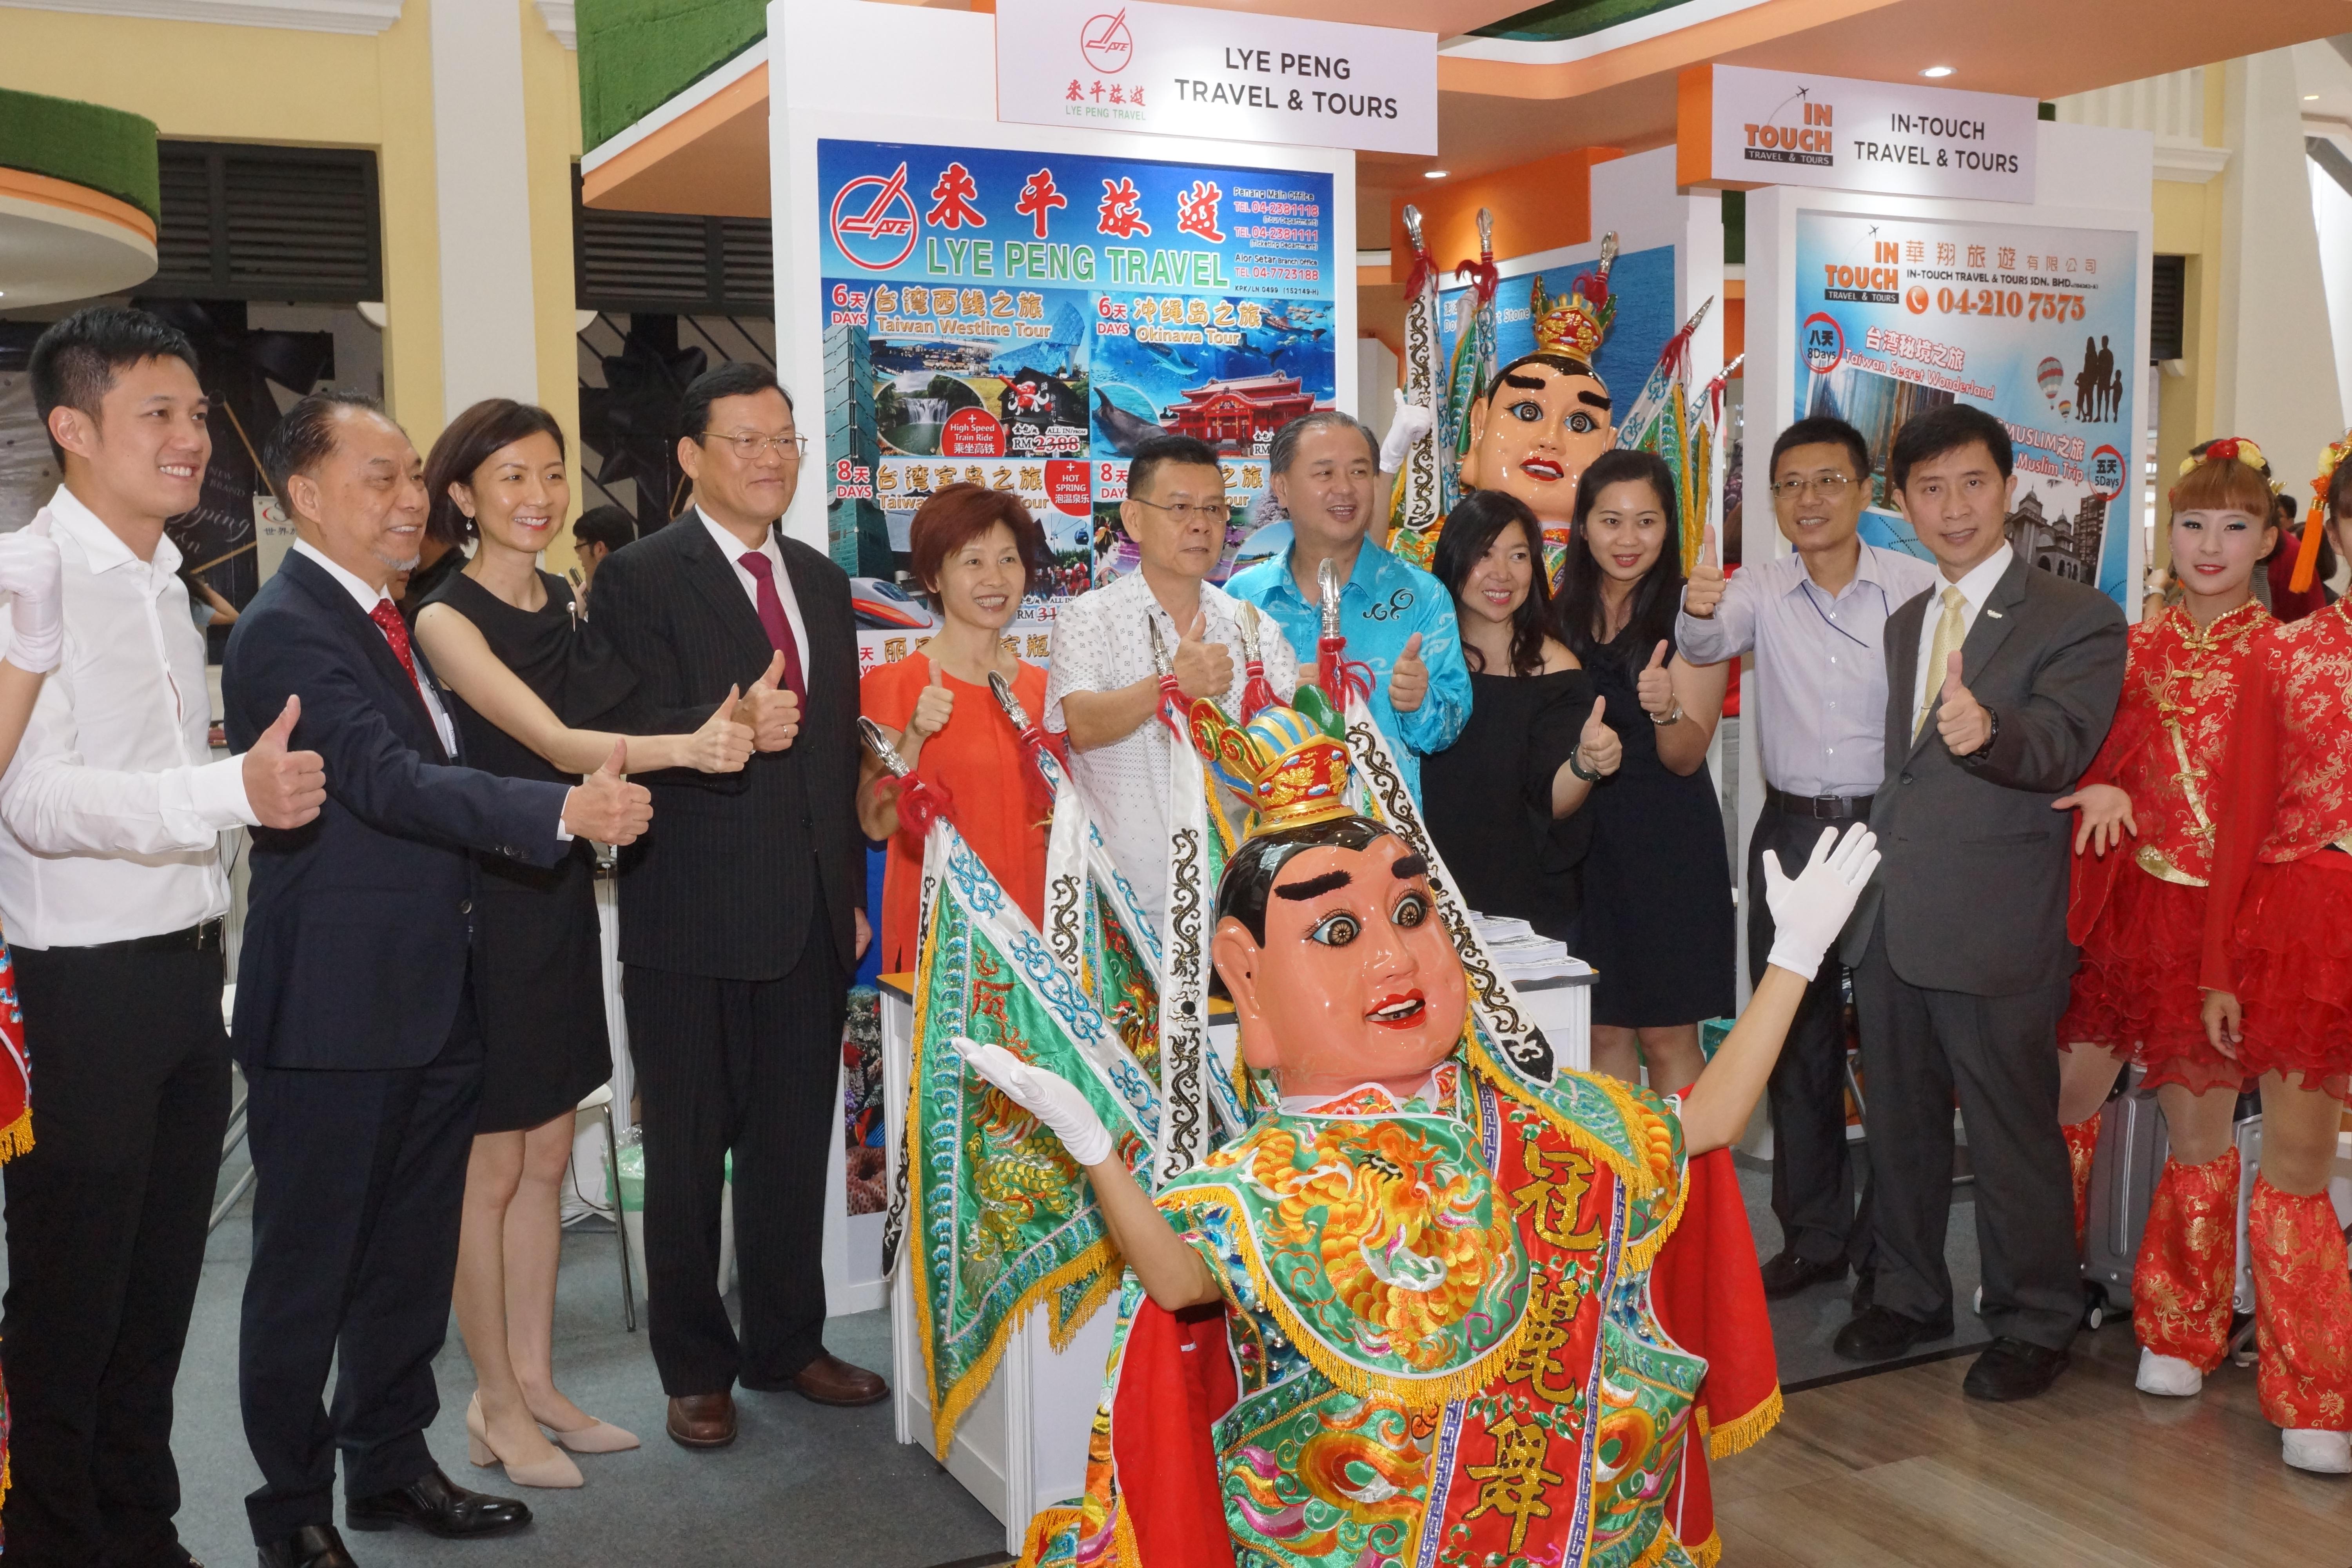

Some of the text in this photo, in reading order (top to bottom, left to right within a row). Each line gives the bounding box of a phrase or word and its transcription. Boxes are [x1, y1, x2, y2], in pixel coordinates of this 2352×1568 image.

[1225, 47, 1350, 80] LYE PENG
[1174, 78, 1397, 119] TRAVEL & TOURS
[1066, 105, 1146, 120] LYE PENG TRAVEL
[1803, 103, 1832, 127] IN
[1891, 113, 1985, 140] IN-TOUCH
[1744, 124, 1832, 153] TOUCH
[1748, 151, 1829, 165] TRAVEL & TOURS
[1854, 141, 2018, 173] TRAVEL & TOURS
[1234, 187, 1314, 201] Penang Main Office
[1234, 201, 1319, 217] TEL 04-2381118
[1281, 217, 1318, 227] Department)
[1234, 226, 1318, 241] TEL 04-2381111
[1250, 240, 1318, 250] (Ticketing Department)
[1875, 241, 1898, 264] IN
[926, 237, 1230, 289] LYE PENG TRAVEL
[1235, 254, 1252, 262] Alor
[1254, 255, 1276, 264] Setar
[1906, 240, 2096, 274] 華翔旅遊 有限公司
[1235, 267, 1319, 281] TEL 04-7723188
[1825, 264, 1898, 290] TOUCH
[1907, 269, 1953, 281] IN-TOUCH
[1956, 272, 1989, 283] TRAVEL
[1991, 274, 1998, 283] &
[2001, 274, 2028, 285] TOURS
[2030, 277, 2049, 286] SDN.
[833, 284, 864, 308] 6天
[1283, 287, 1319, 296] (152149-H)
[1829, 291, 1896, 302] TRAVEL & TOURS
[875, 286, 1043, 319] 台湾西线之旅
[1098, 297, 1126, 319] 6天
[1937, 287, 2086, 324] 04-210 7575
[832, 311, 867, 325] DAYS
[1134, 298, 1260, 327] 冲绳岛之旅
[1504, 308, 1530, 322] Stone
[877, 316, 1051, 338] Taiwan Westline Tour
[1098, 323, 1128, 334] DAYS
[1137, 327, 1240, 344] Okinawa Tour
[1809, 329, 1834, 347] 八天
[1807, 348, 1836, 362] 8Days
[1866, 325, 1965, 371] 台湾秘境之旅
[1845, 348, 1996, 401] Taiwan Secret Wonderland
[951, 424, 995, 433] High Speed
[954, 443, 995, 454] 乘坐高铁
[1014, 437, 1078, 450] RM 2388
[1255, 445, 1270, 454] RM
[837, 460, 869, 483] 8天
[1101, 463, 1129, 483] 8天
[2016, 452, 2084, 487] Muslim Trip
[2096, 459, 2117, 474] 五天
[2094, 475, 2119, 488] 5Days
[837, 486, 872, 498] DAYS
[1055, 494, 1089, 504] 泡温泉乐
[879, 495, 924, 509] Taiwa
[1224, 496, 1249, 505] our
[1017, 610, 1034, 619] RM
